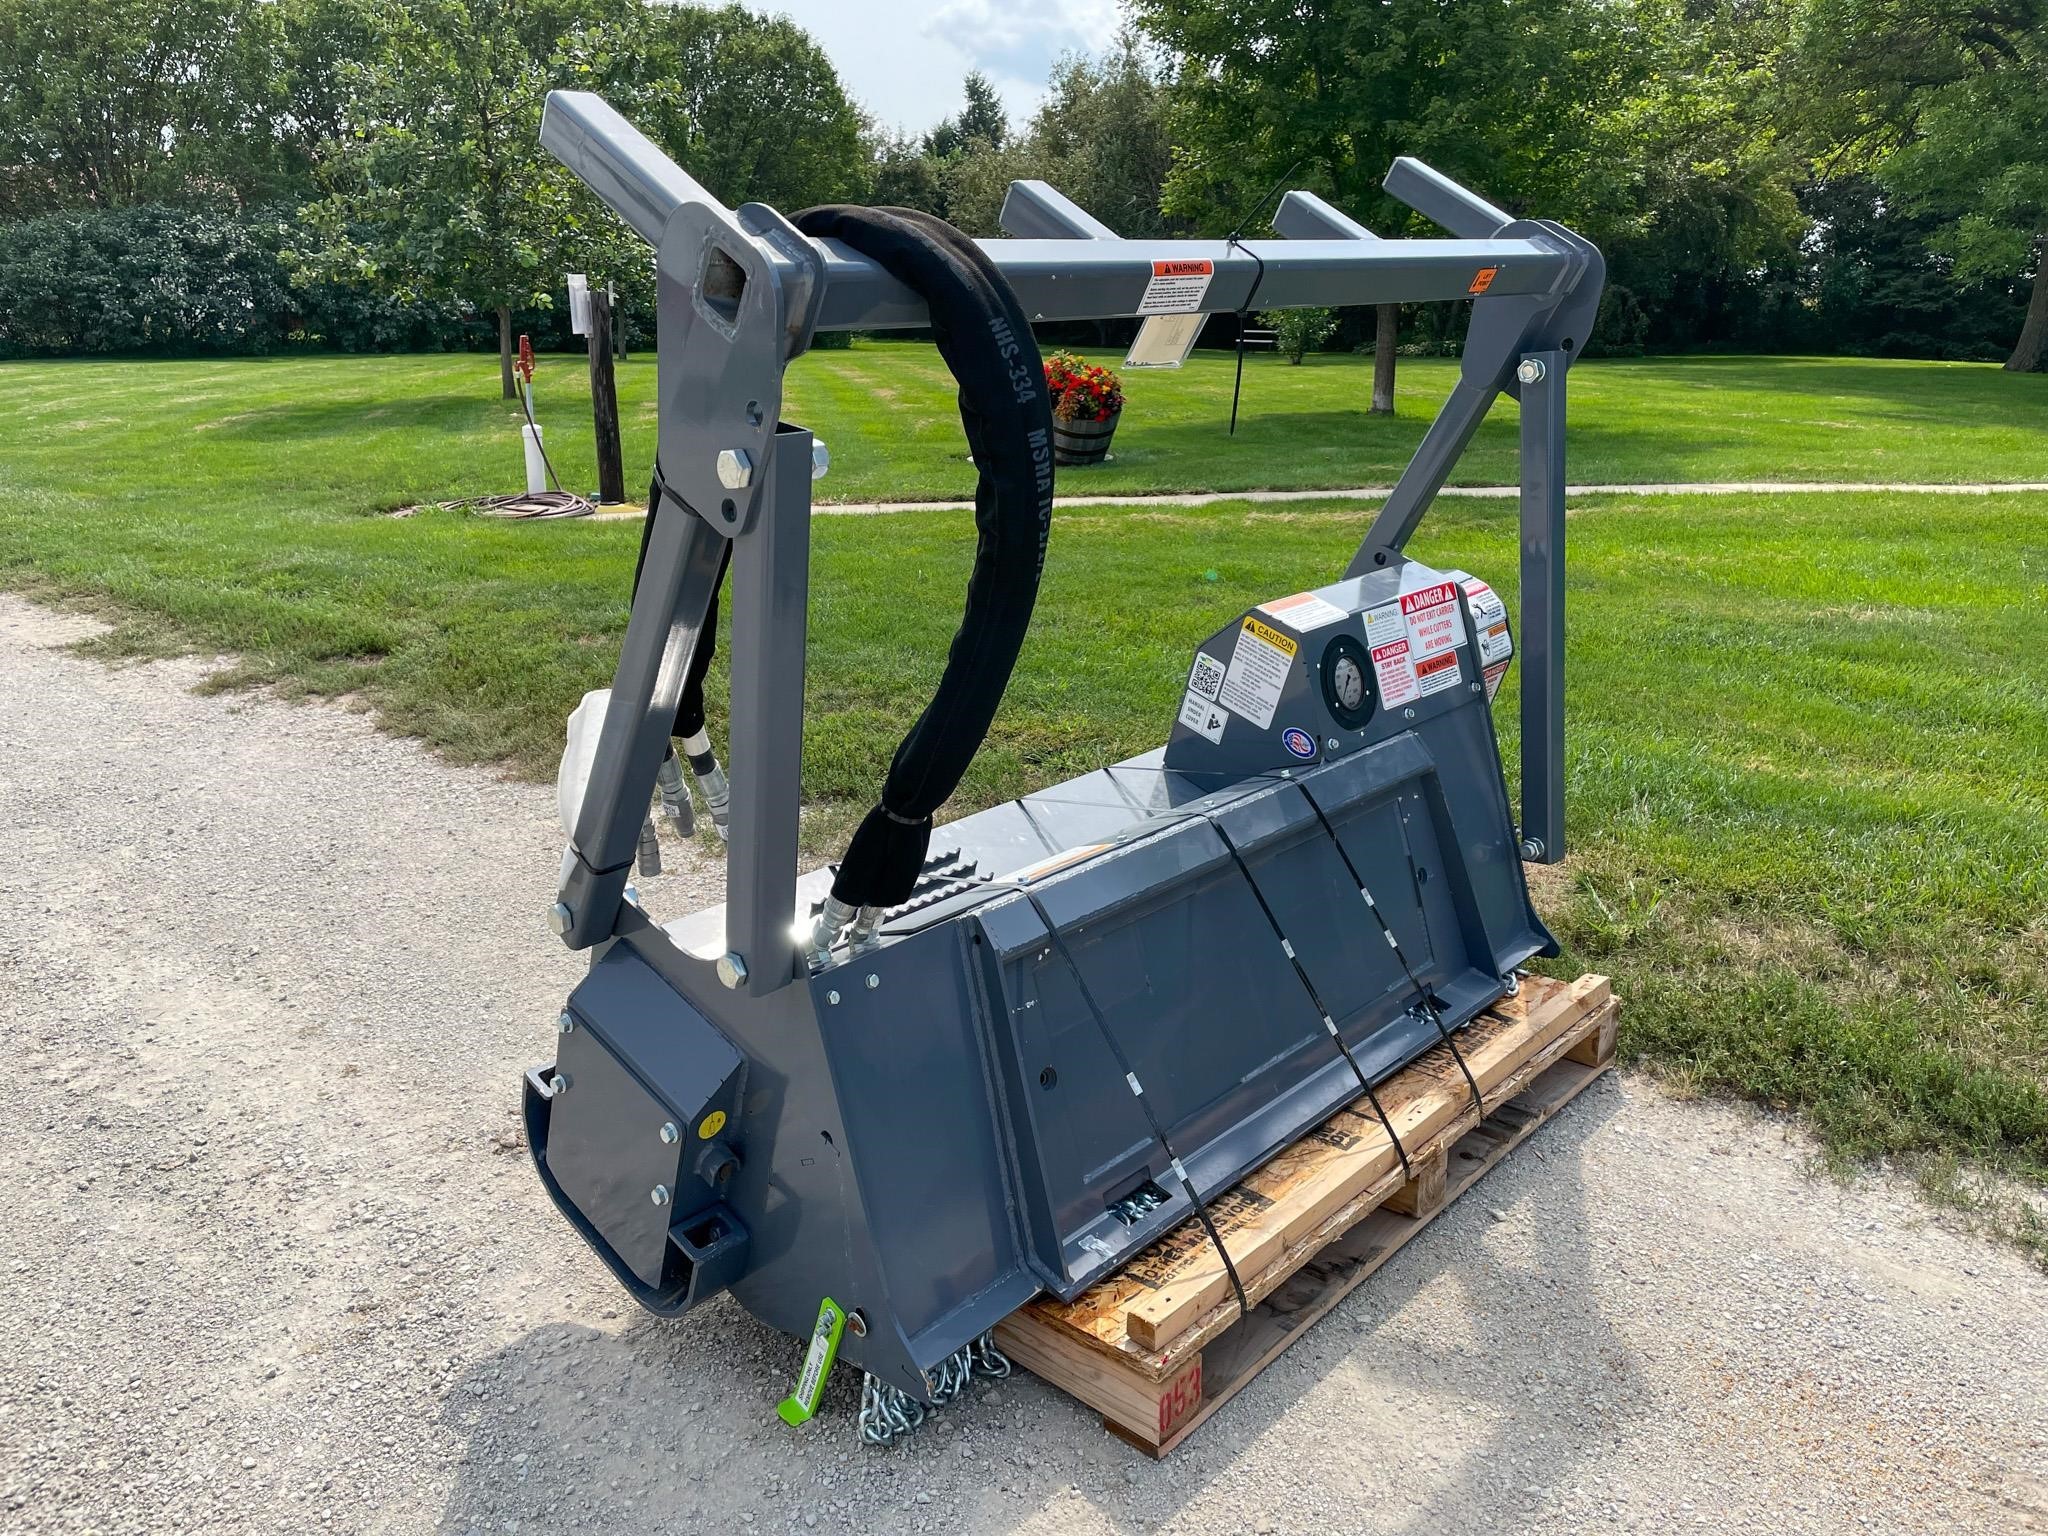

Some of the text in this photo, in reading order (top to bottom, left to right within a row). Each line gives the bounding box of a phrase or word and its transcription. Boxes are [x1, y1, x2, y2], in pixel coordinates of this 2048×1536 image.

[1172, 263, 1204, 273] WARNING
[988, 317, 1037, 404] NHS-334
[1027, 427, 1050, 493] MSHA
[1414, 588, 1444, 610] DANGER
[1409, 604, 1455, 626] DO NOT EXIT CARRIER
[1418, 620, 1452, 637] WHILE CUTTERS
[1257, 625, 1294, 650] CAUTION
[1424, 634, 1452, 650] ARE MOVING
[1382, 643, 1407, 657] DANGER
[1381, 656, 1406, 670] STAY BACK
[1428, 656, 1453, 668] WARNING
[1188, 698, 1205, 711] MANUAL
[1188, 706, 1202, 717] UNDER
[1186, 714, 1199, 724] COVER
[810, 1363, 820, 1386] BEFORE
[1160, 1368, 1200, 1432] 053
